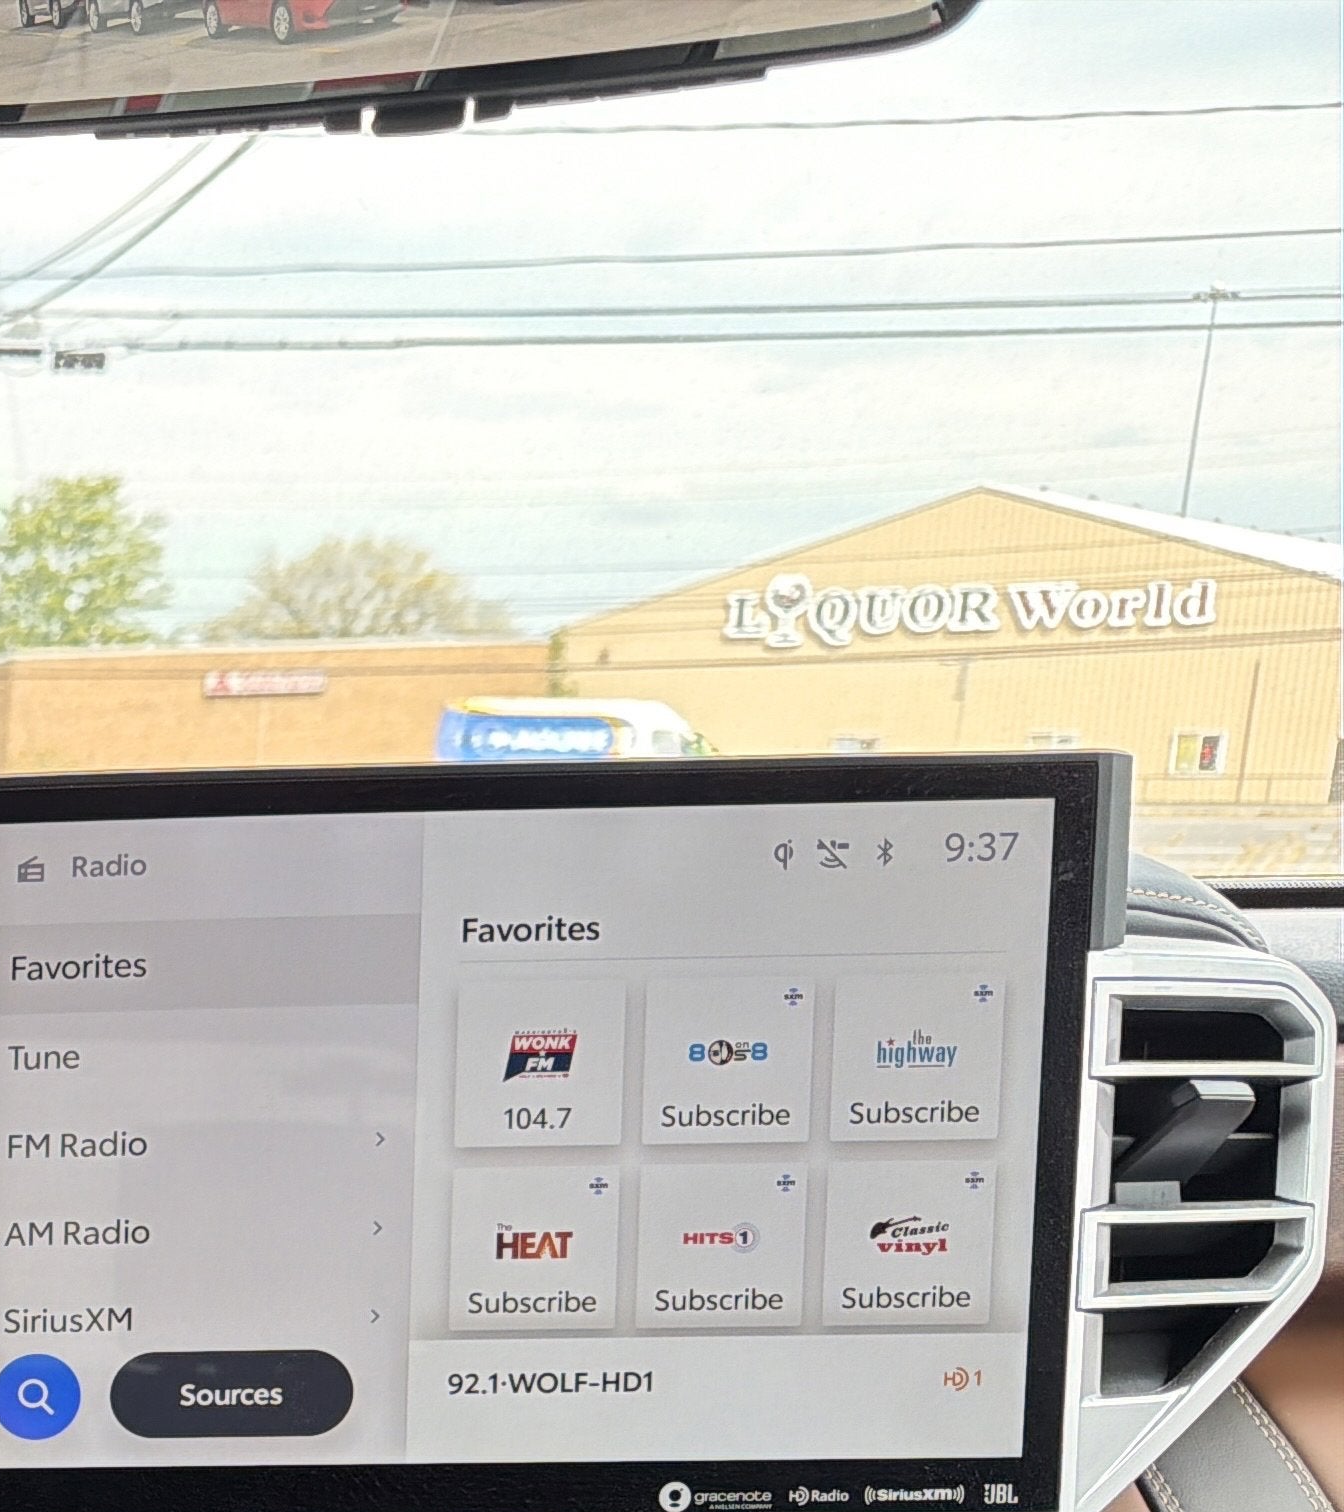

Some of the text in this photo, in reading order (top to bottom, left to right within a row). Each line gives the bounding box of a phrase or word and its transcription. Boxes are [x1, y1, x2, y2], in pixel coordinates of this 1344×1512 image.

[1008, 578, 1217, 631] World
[944, 832, 1020, 864] 9:37
[72, 854, 148, 879] Radio
[461, 917, 601, 945] Favorites
[10, 953, 148, 982] Favorites
[514, 1036, 573, 1051] WONK
[876, 1040, 958, 1069] highway
[8, 1045, 81, 1072] Tune
[525, 1057, 555, 1072] FM
[503, 1107, 572, 1130] 104.7
[660, 1103, 791, 1129] Subscribe
[849, 1101, 980, 1125] Subscribe
[7, 1132, 149, 1160] FM Radio
[4, 1219, 150, 1247] AM Radio
[890, 1221, 950, 1238] Classic
[496, 1231, 574, 1260] HEAT
[877, 1239, 948, 1256] vinyl
[467, 1289, 597, 1315] Subscribe
[654, 1287, 784, 1313] Subscribe
[841, 1285, 971, 1311] Subscribe
[3, 1307, 133, 1334] SiriusXM
[178, 1383, 284, 1407] Sources
[694, 1490, 772, 1506] gracenote
[812, 1489, 850, 1503] Radio
[984, 1484, 1019, 1505] JBL
